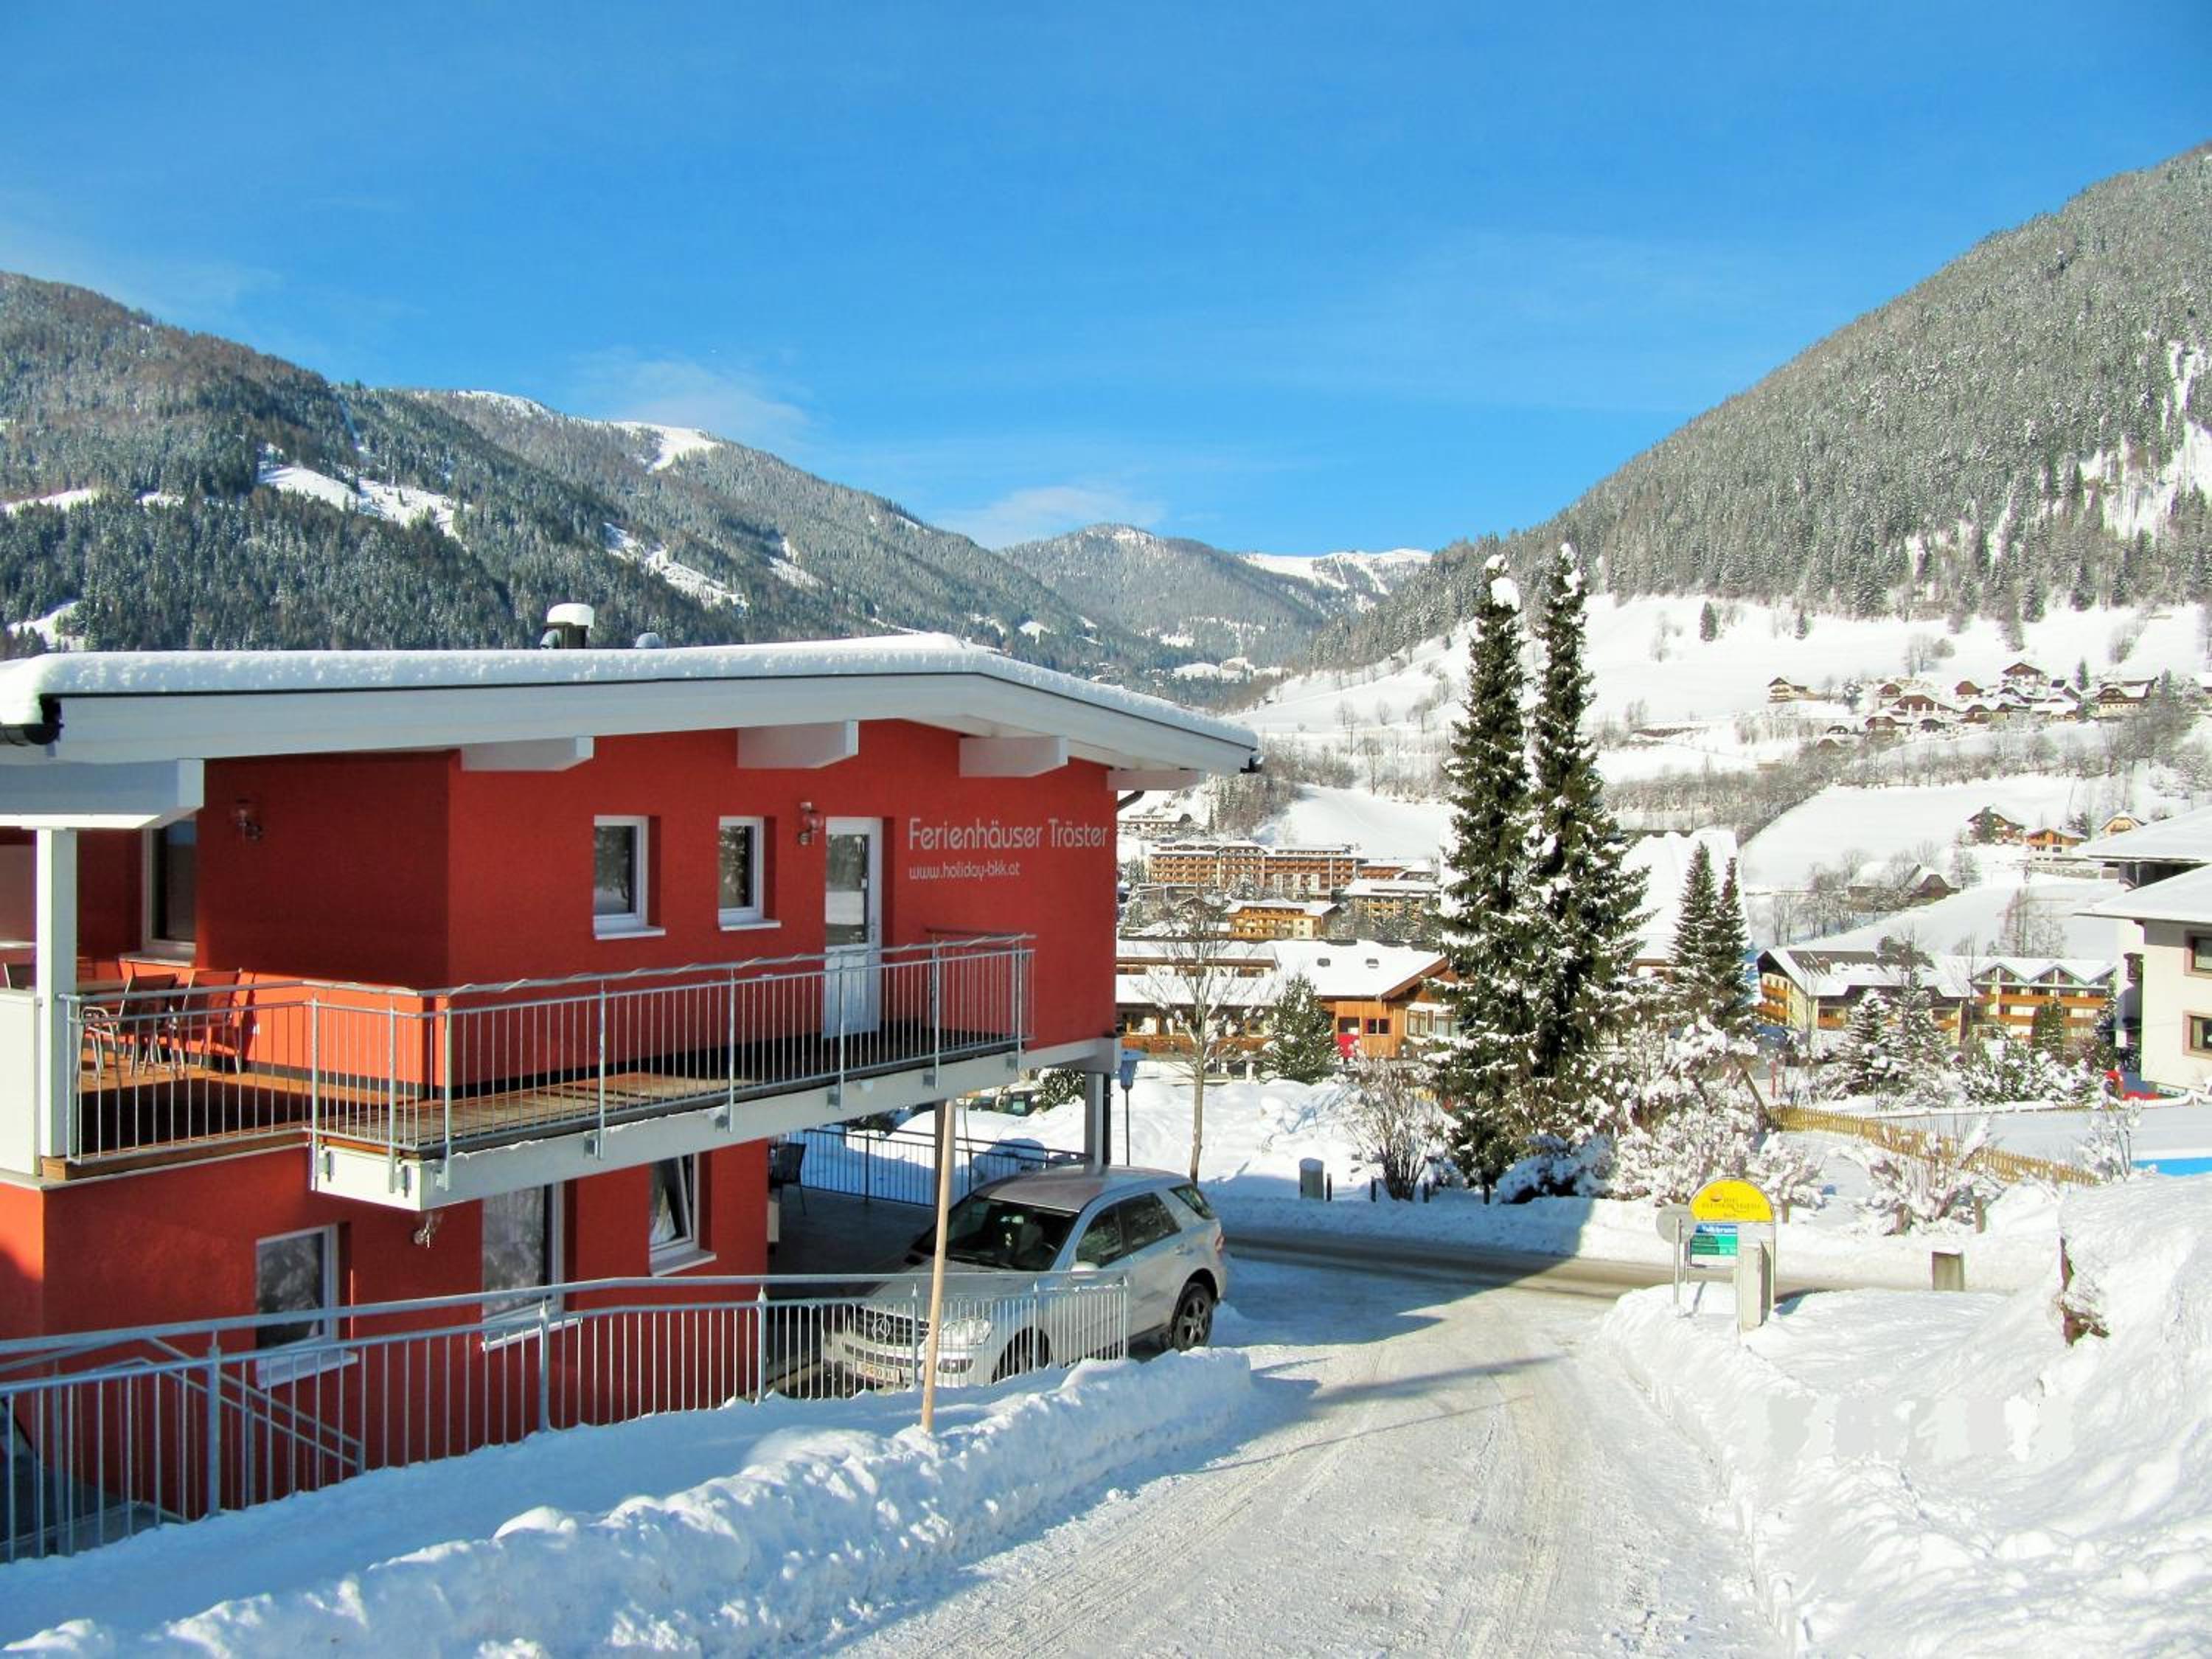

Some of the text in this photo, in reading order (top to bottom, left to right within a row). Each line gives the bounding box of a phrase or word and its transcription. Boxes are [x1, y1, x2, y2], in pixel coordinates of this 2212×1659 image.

[908, 818, 1108, 849] Ferienhäuser Tröster
[908, 860, 1020, 881] www.holiday-bkk.at
